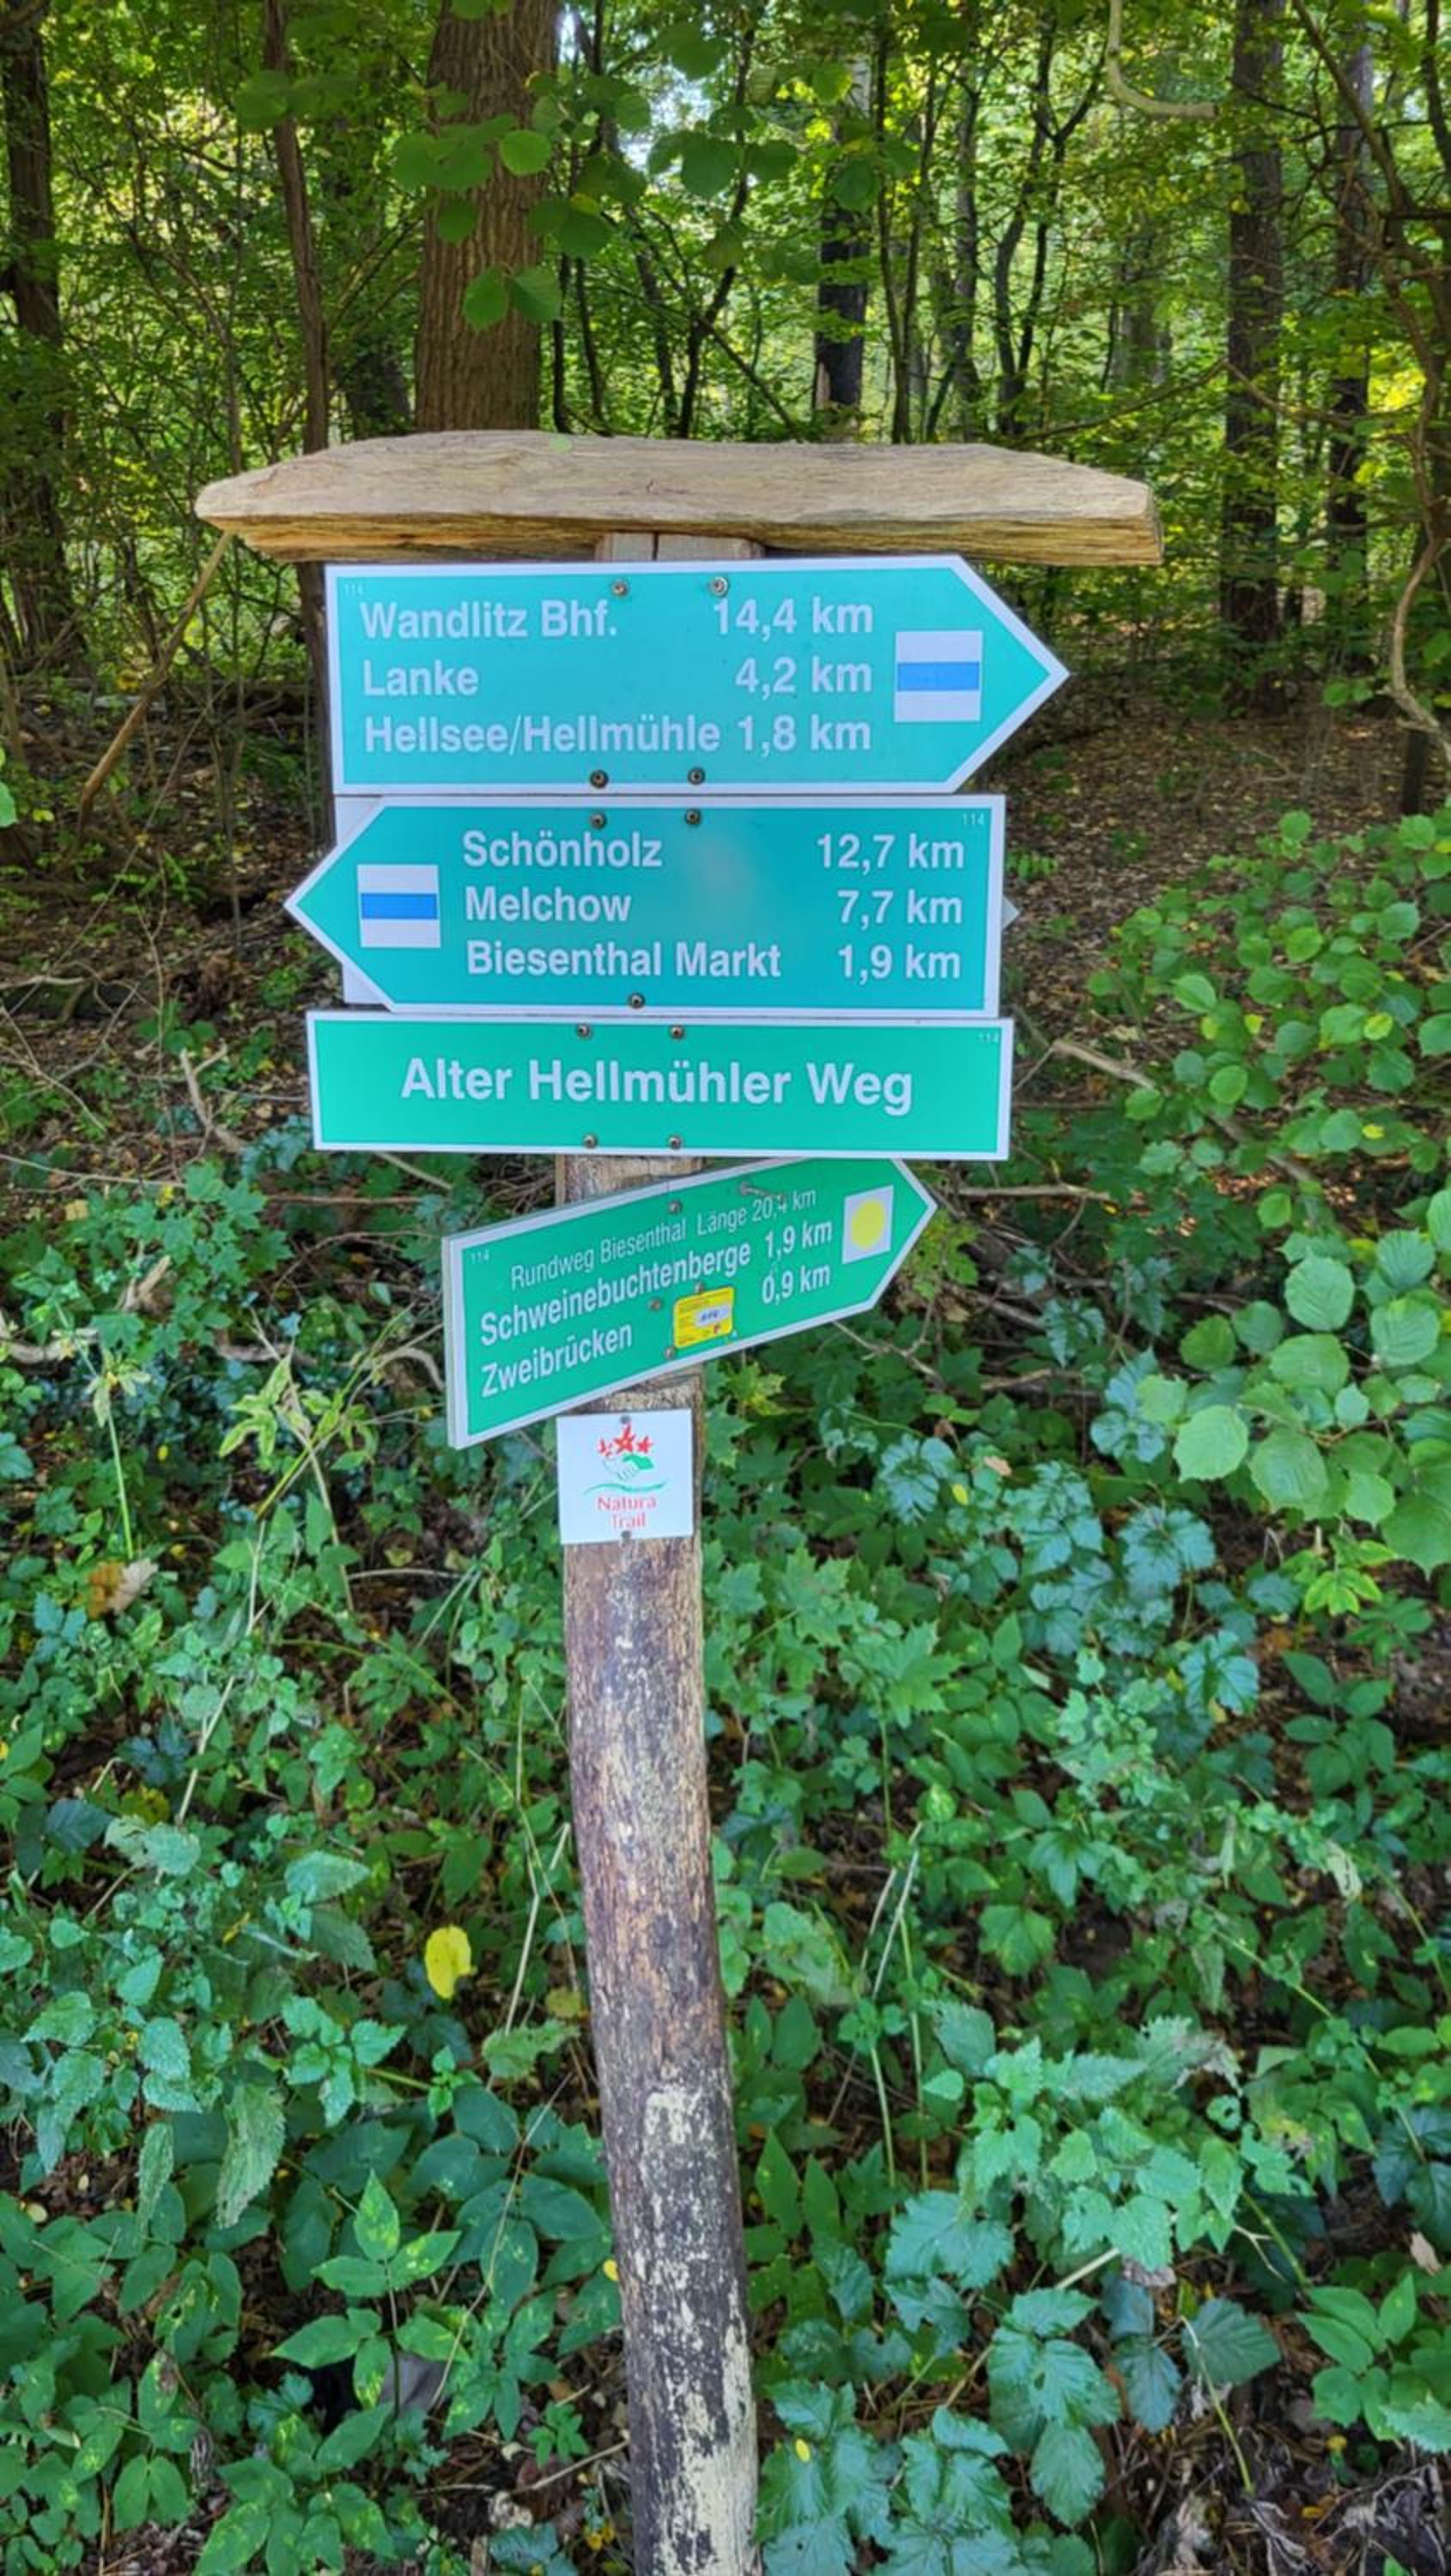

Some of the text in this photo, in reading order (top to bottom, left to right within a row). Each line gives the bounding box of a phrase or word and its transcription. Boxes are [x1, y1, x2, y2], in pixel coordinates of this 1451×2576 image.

[360, 598, 873, 642] Wandlitz Bhf. 14,4 km
[363, 657, 872, 700] Lanke 4,2 km
[365, 714, 871, 758] Hellsee/Hellmühle 1,8 km
[962, 811, 985, 826] 114
[462, 832, 964, 874] Schönholz 12,7 km
[466, 886, 962, 929] Melchow 7,7 km
[468, 940, 961, 984] Biesenthal Markt 1,9 km
[401, 1058, 913, 1116] Alter Hellmühler Weg
[511, 1248, 594, 1290] Rundweg
[601, 1219, 686, 1263] Biesenthal
[697, 1207, 747, 1236] Länge
[792, 1189, 816, 1210] km
[481, 1242, 750, 1346] Schweinebuchtenberge
[765, 1225, 796, 1261] 1,9
[802, 1221, 832, 1249] km
[483, 1265, 830, 1397] Zweibrücken 0,9 km
[597, 1496, 657, 1511] Natura
[611, 1512, 646, 1528] Trail
